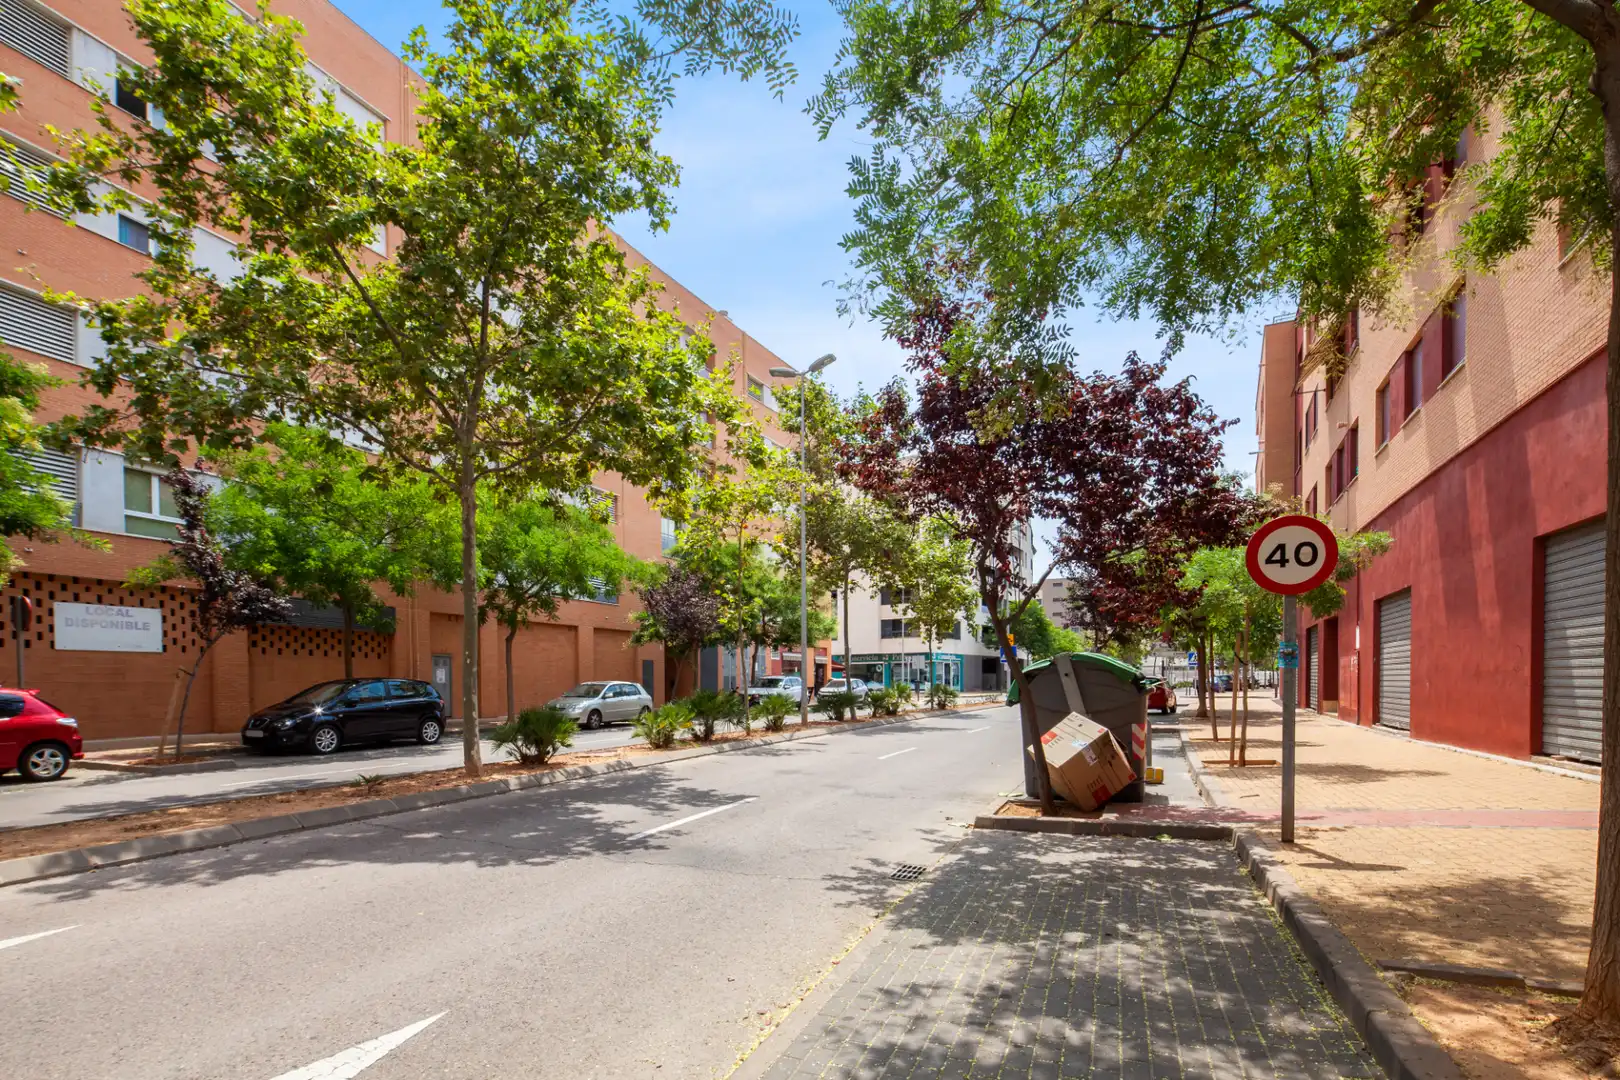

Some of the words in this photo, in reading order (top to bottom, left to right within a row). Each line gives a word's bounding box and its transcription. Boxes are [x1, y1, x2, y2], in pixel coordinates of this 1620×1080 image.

[1265, 541, 1318, 568] 40
[85, 606, 134, 618] LOCAL
[64, 616, 151, 631] DISPONIBLE
